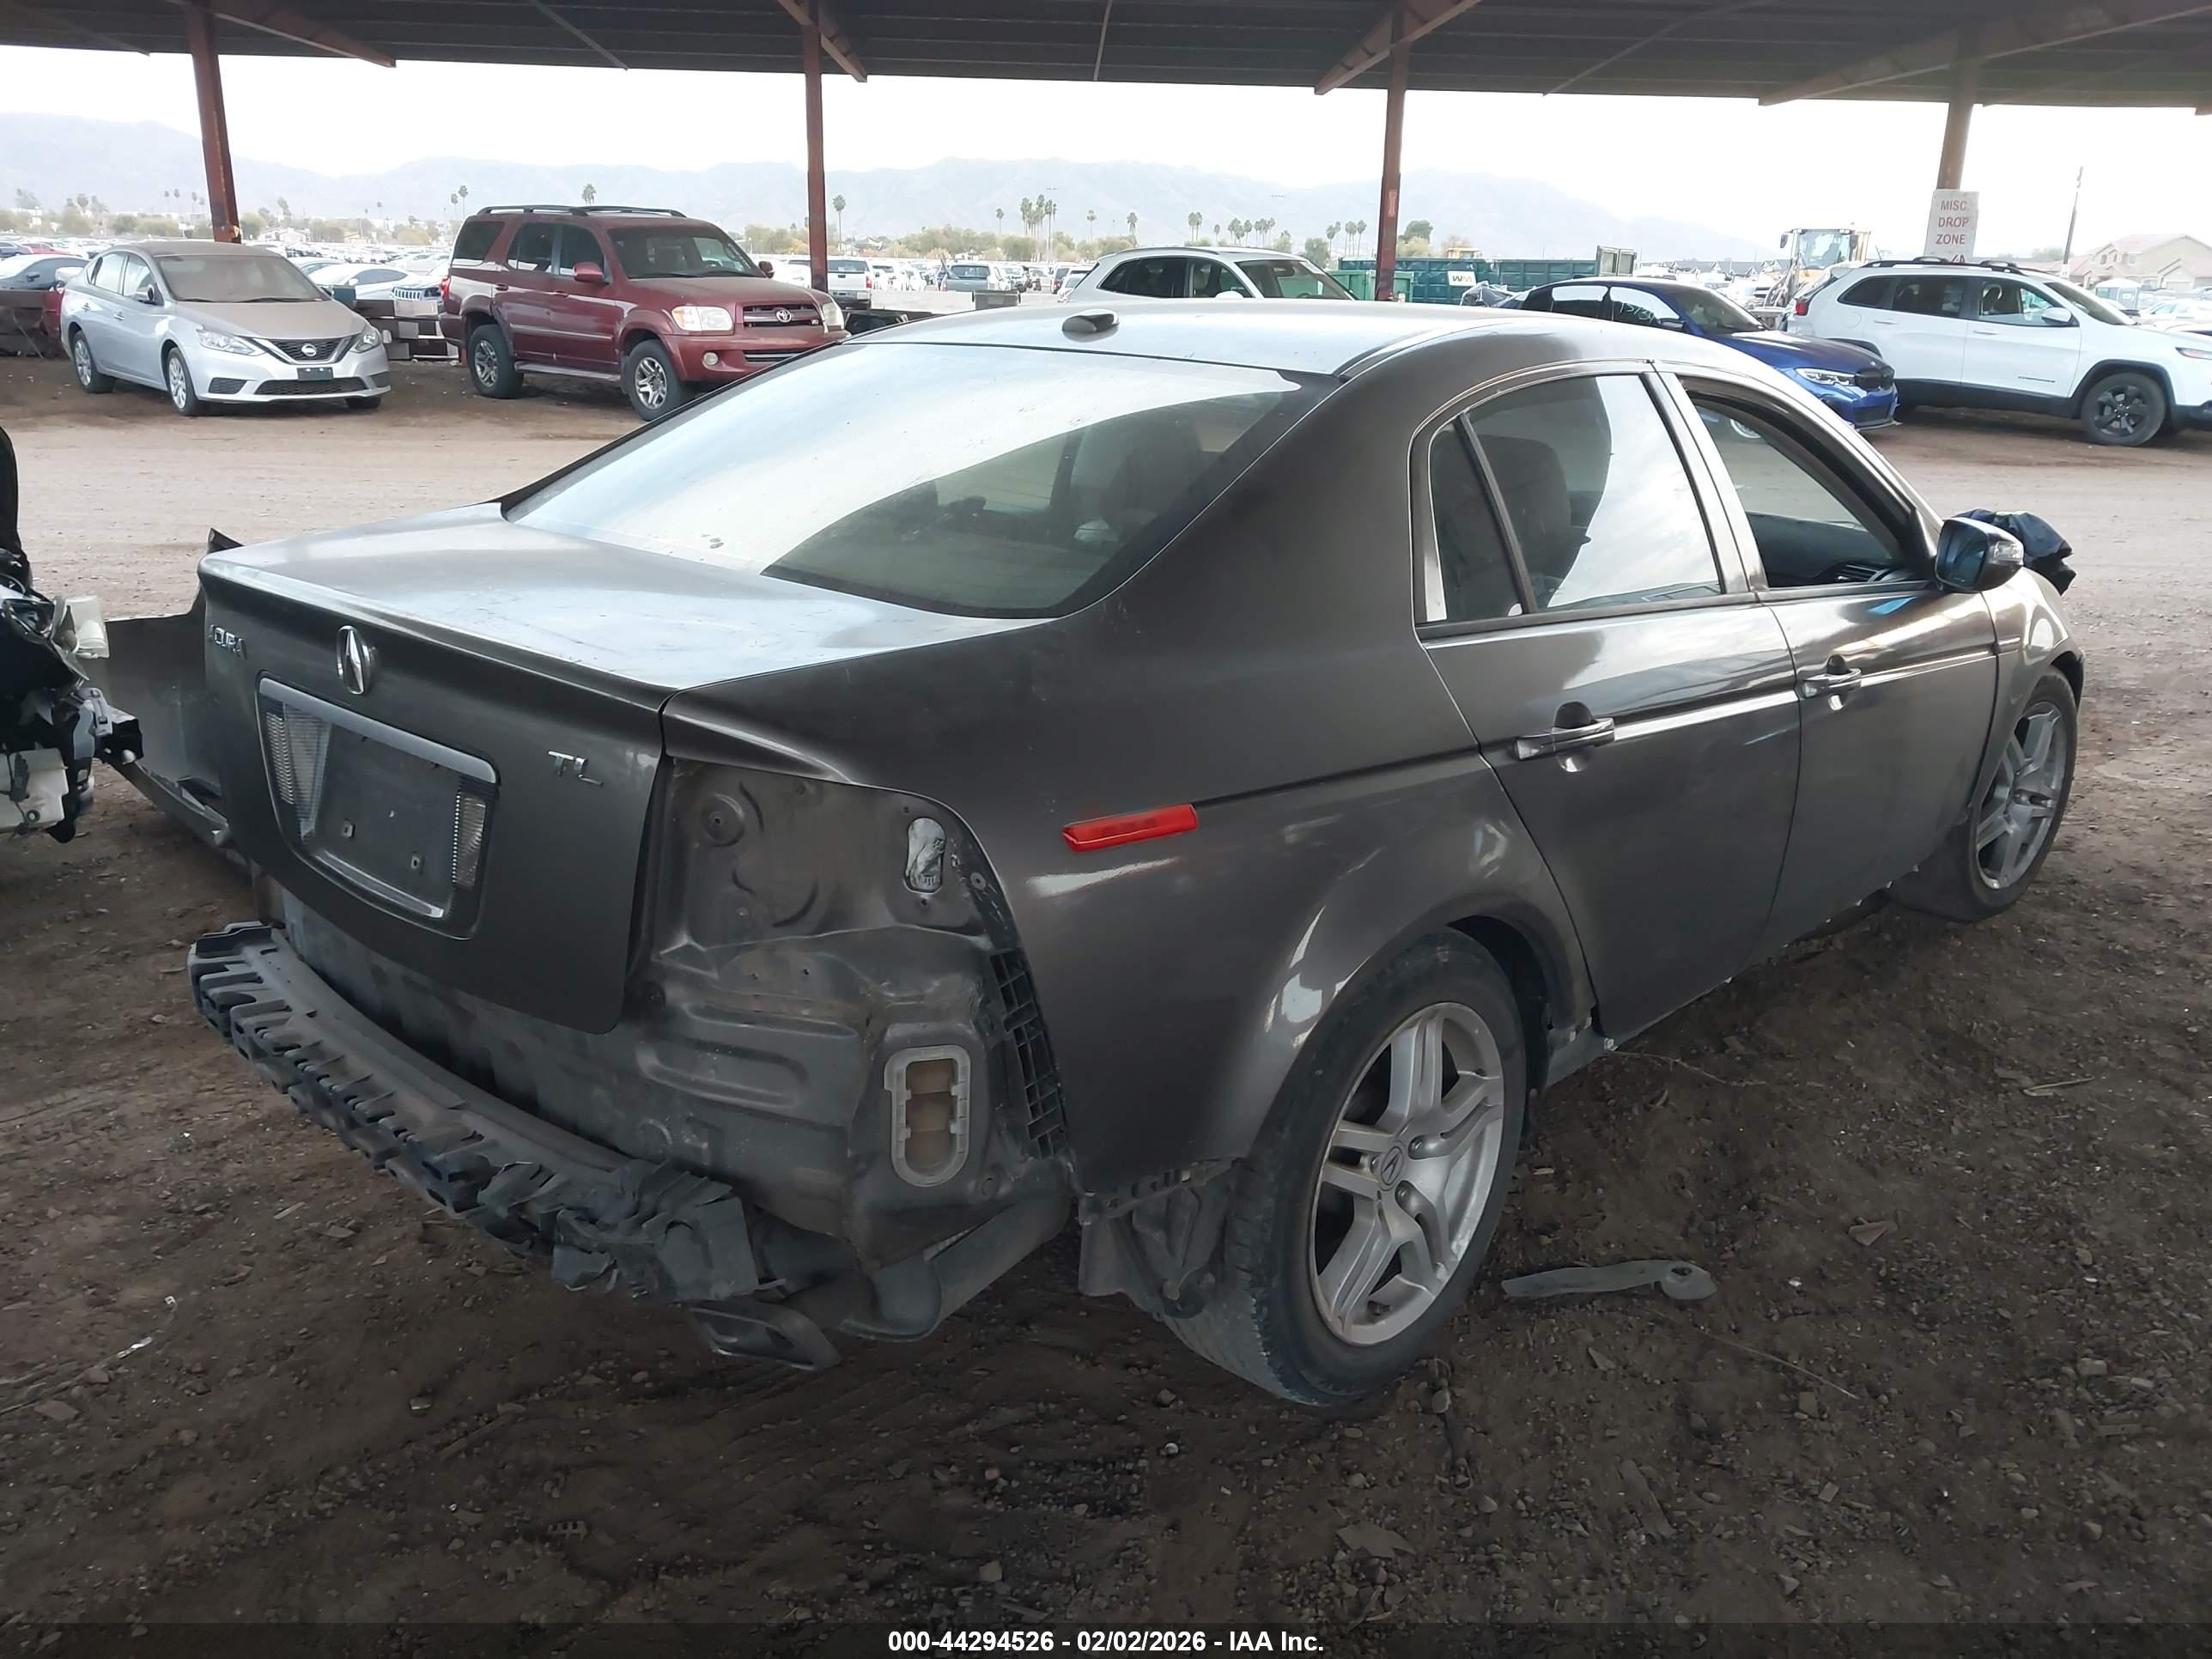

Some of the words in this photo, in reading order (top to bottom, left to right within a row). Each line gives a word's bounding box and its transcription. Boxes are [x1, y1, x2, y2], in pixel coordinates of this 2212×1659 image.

[1940, 199, 1970, 211] MISC.
[1937, 216, 1969, 228] DROP
[1936, 234, 1966, 245] ZONE
[548, 750, 603, 786] TL
